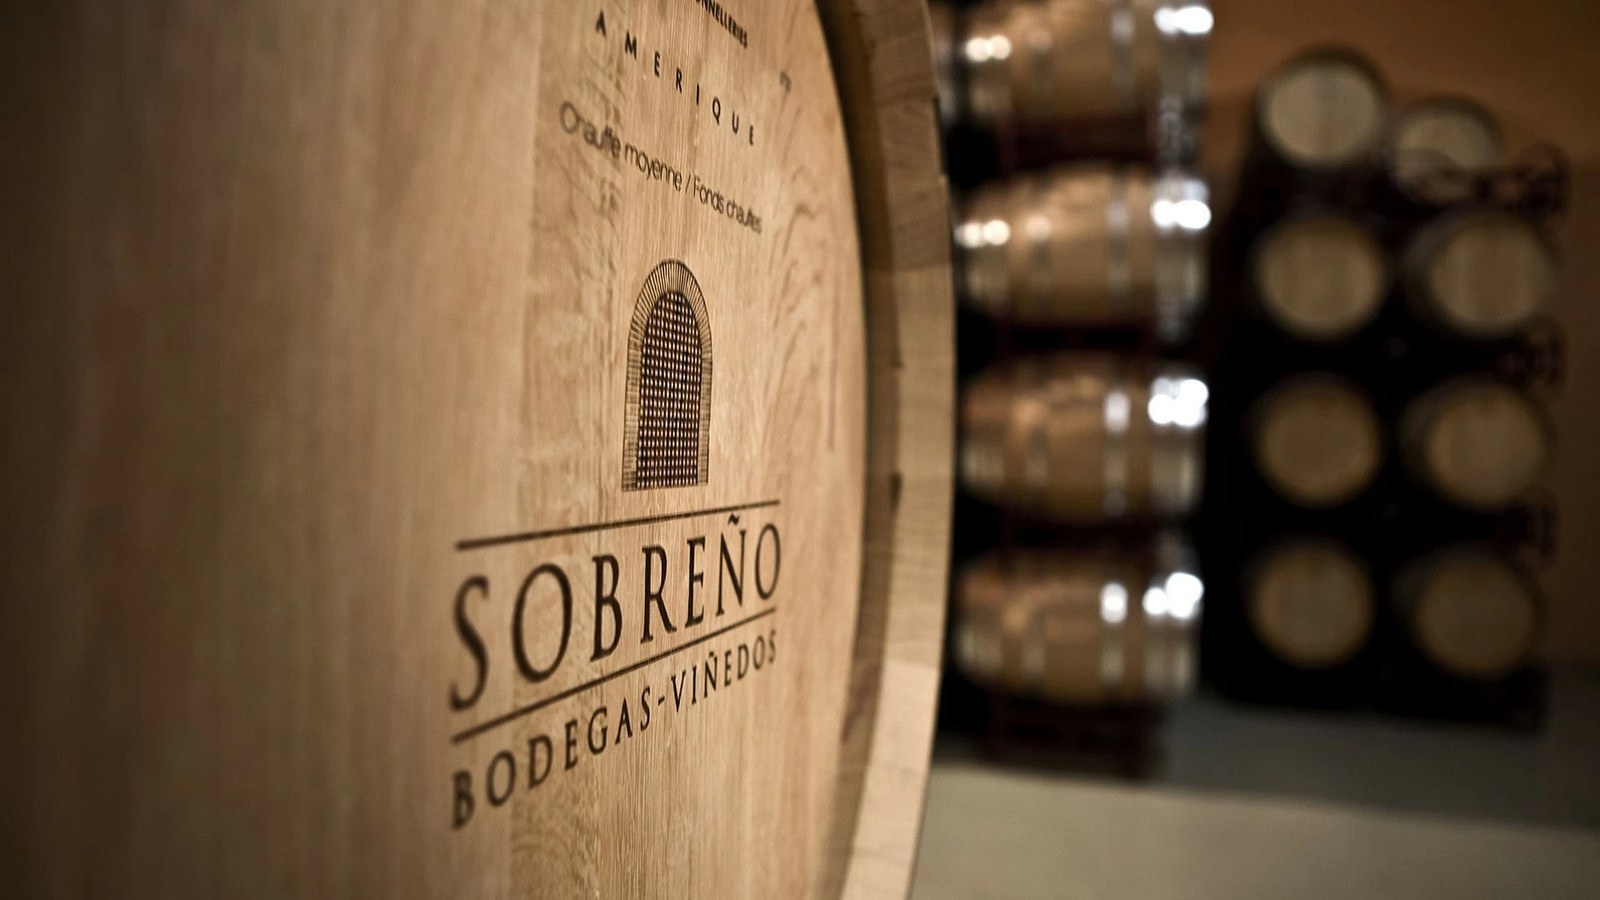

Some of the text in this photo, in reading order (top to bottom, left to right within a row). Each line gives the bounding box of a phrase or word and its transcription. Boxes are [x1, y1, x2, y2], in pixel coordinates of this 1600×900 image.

[595, 9, 754, 146] AMERIQUE
[624, 143, 683, 192] moyenne
[693, 174, 724, 215] Fonds
[449, 513, 781, 712] SOBREÑO
[452, 629, 777, 830] BODEGAS-VIÑEDOS
